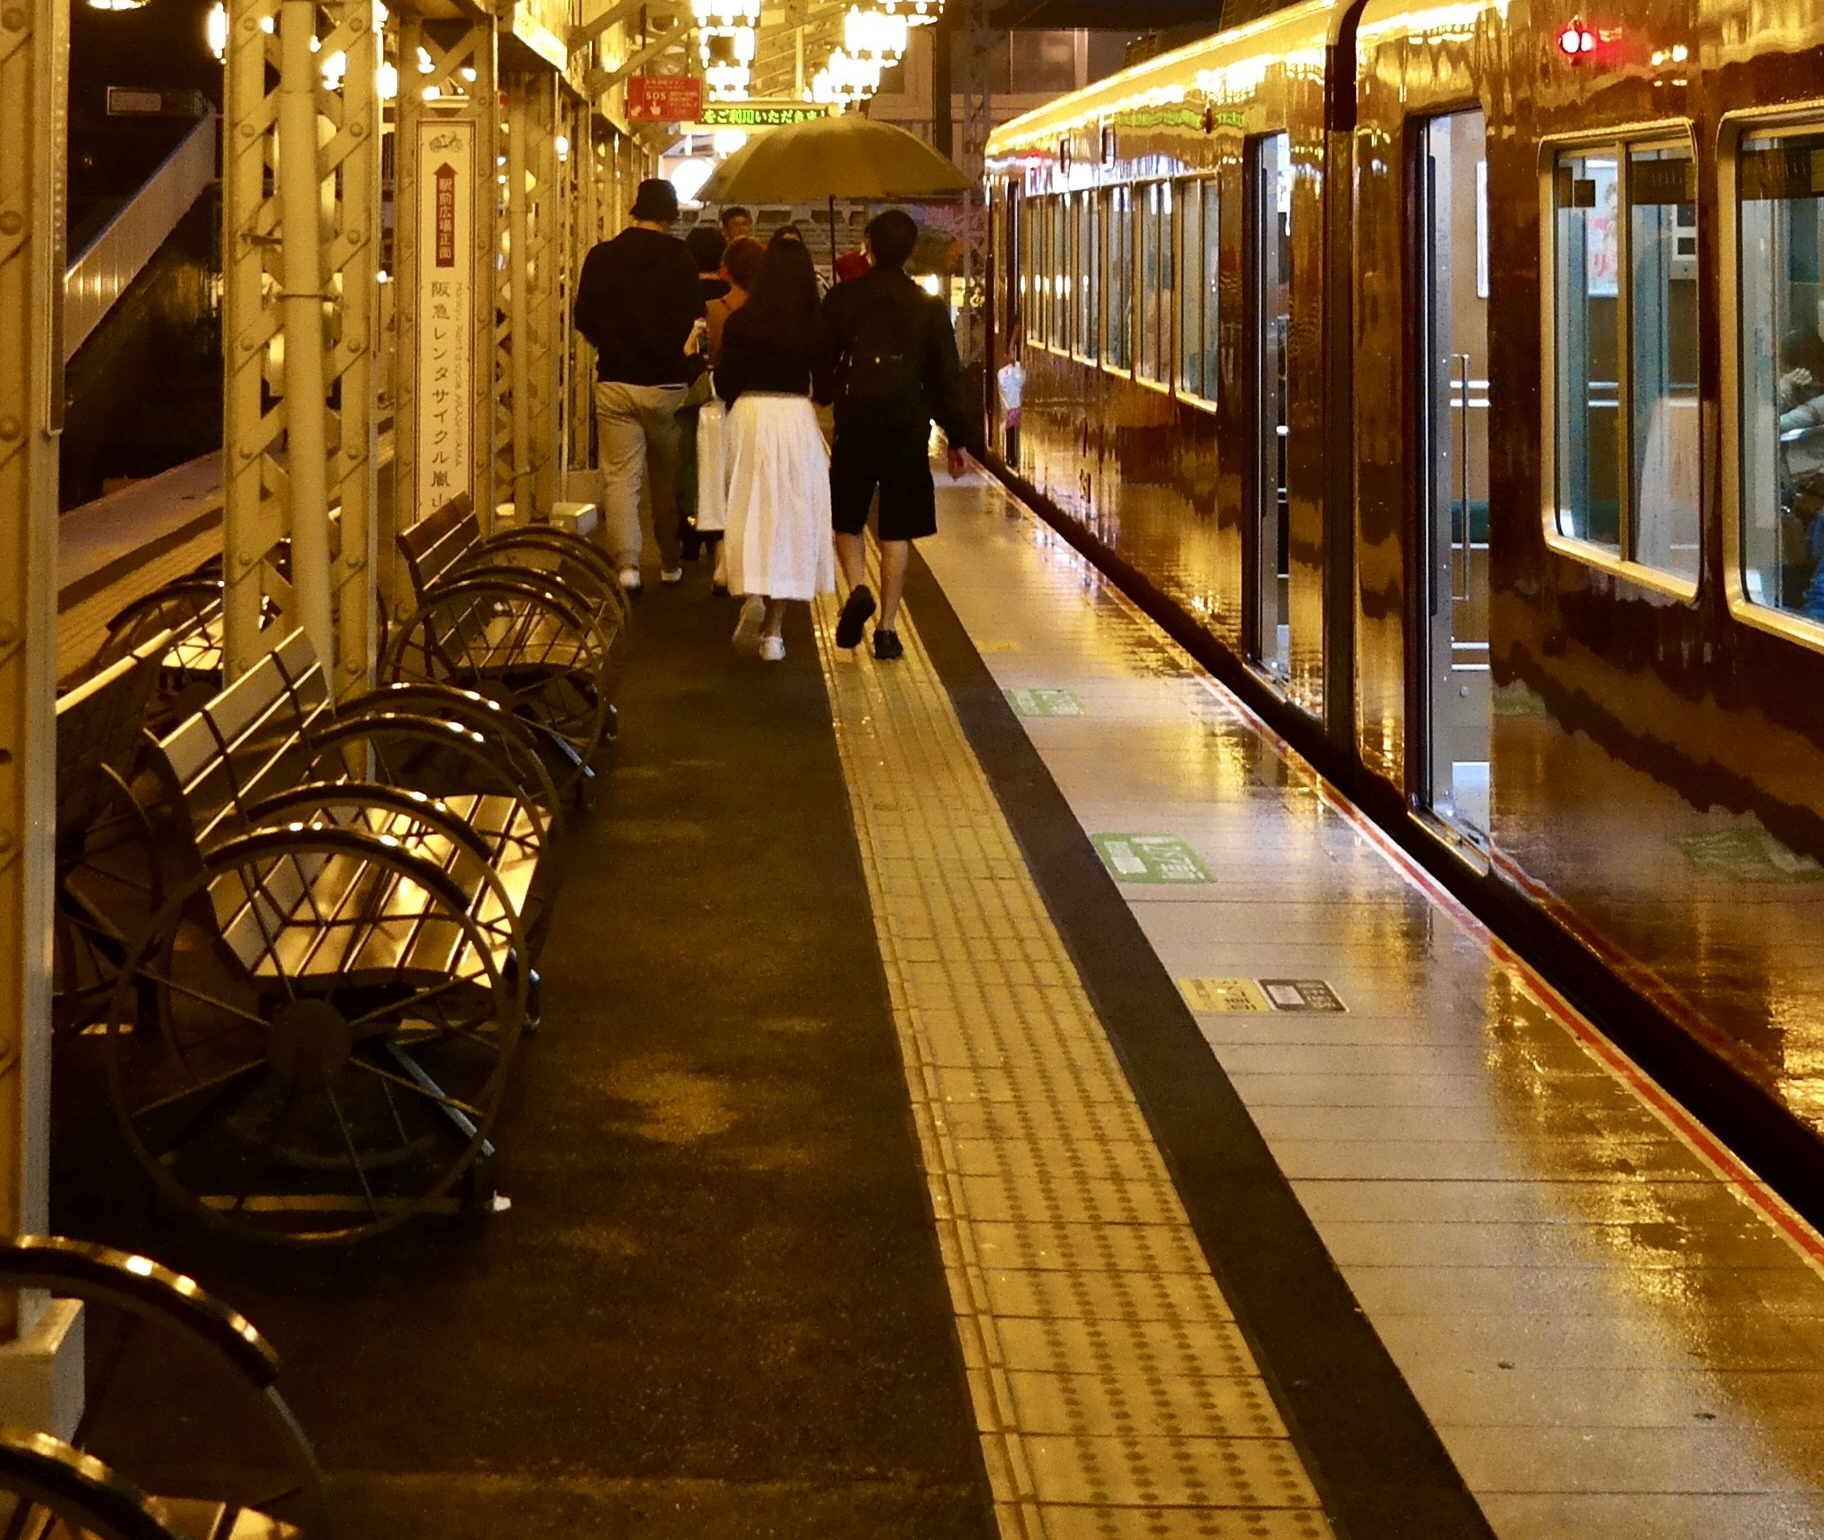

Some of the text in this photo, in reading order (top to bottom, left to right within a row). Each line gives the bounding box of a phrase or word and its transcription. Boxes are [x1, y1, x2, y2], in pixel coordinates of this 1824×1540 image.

[438, 178, 452, 260] 駅前広場正面
[431, 281, 450, 508] 阪急レンタサイクル嵐山
